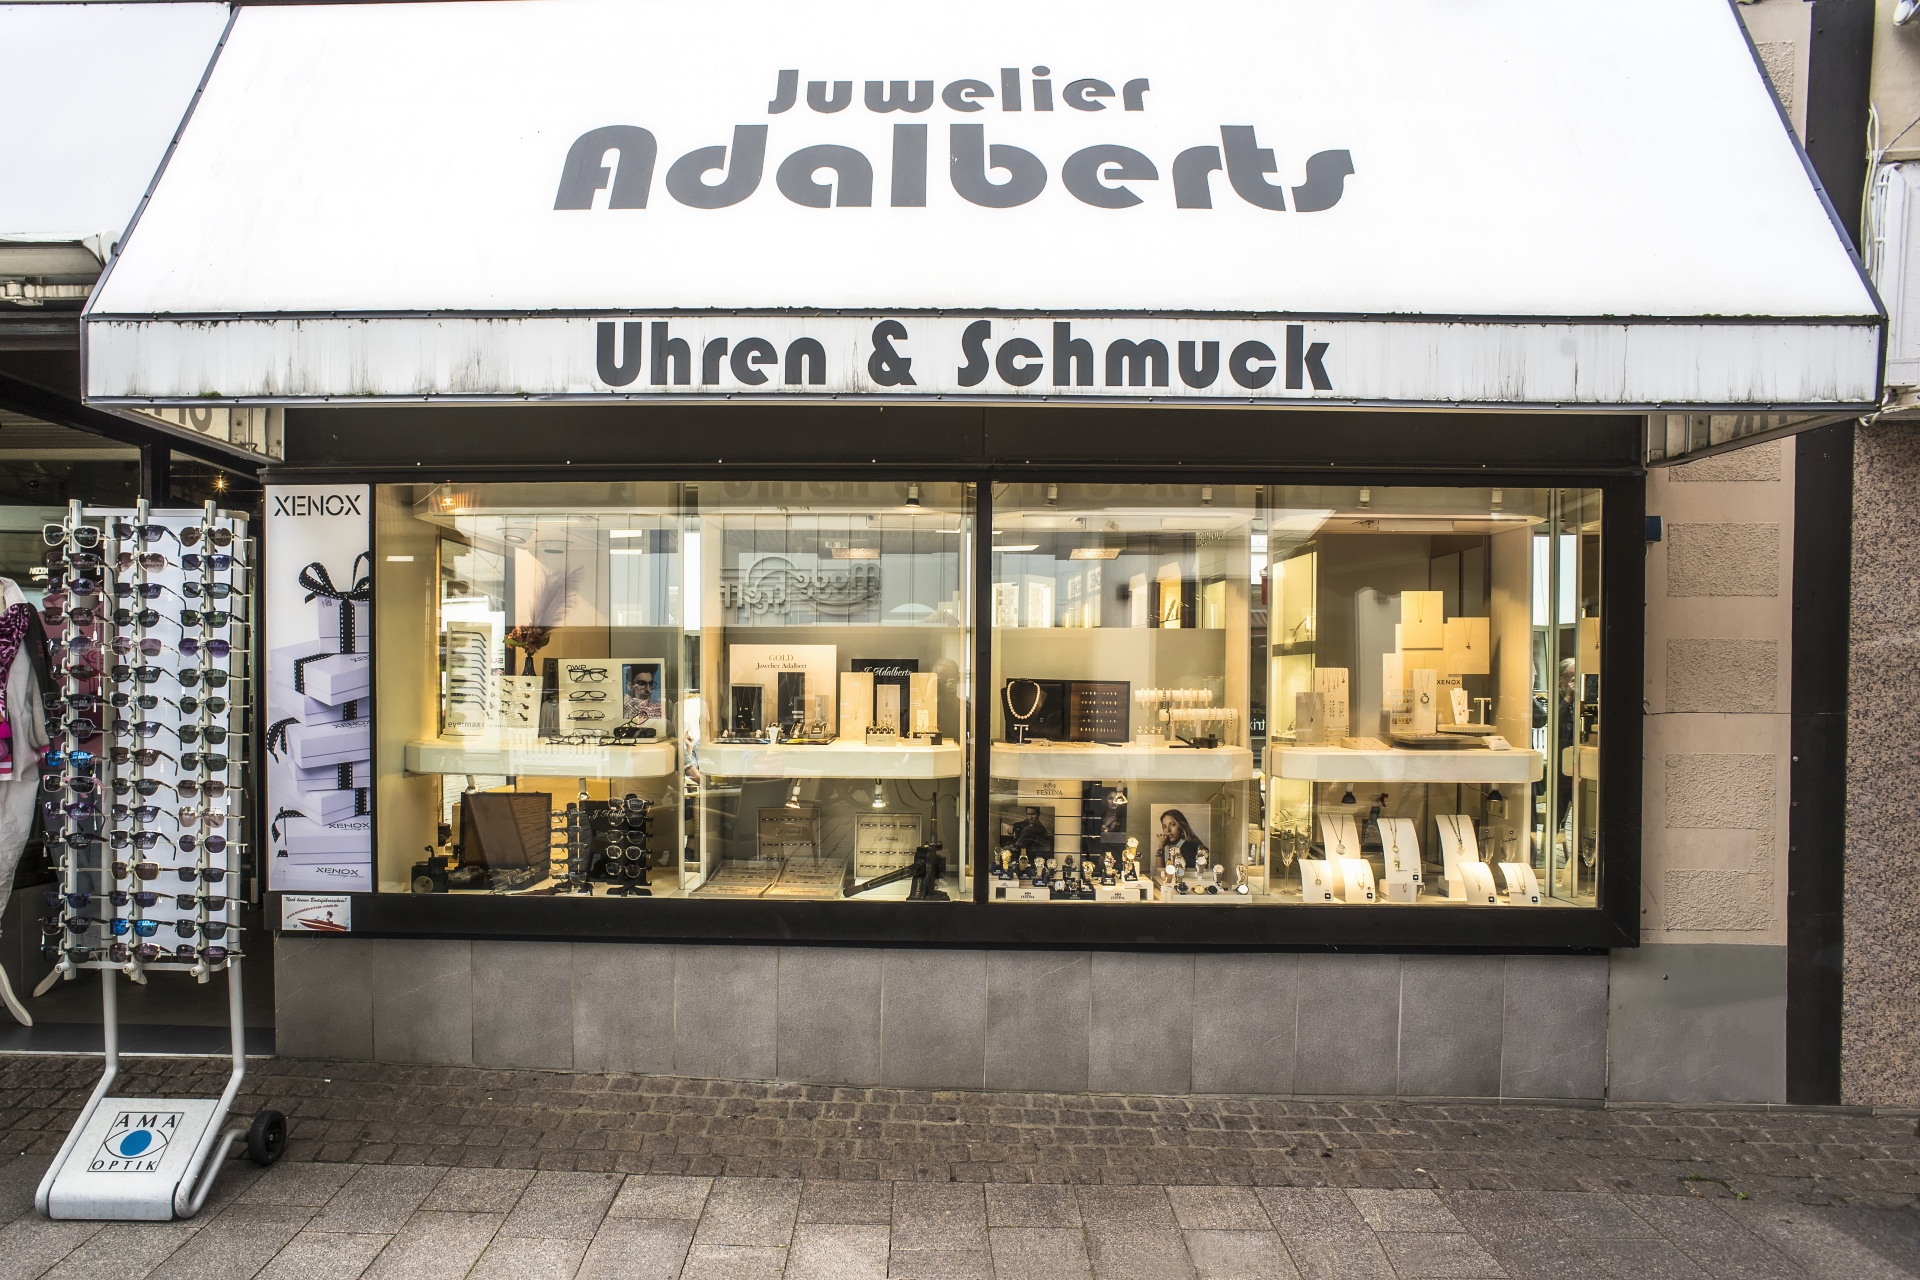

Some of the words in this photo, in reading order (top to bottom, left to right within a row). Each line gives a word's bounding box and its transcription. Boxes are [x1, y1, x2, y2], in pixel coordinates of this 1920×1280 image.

[768, 66, 1150, 114] Juwelier
[553, 123, 1355, 213] Adalberts
[597, 321, 827, 388] Uhren
[867, 319, 918, 388] &
[957, 320, 1333, 391] Schmuck
[273, 494, 362, 516] XENOX
[315, 867, 359, 876] XENOX
[114, 1113, 176, 1128] AMA
[91, 1160, 158, 1171] OPTIK
